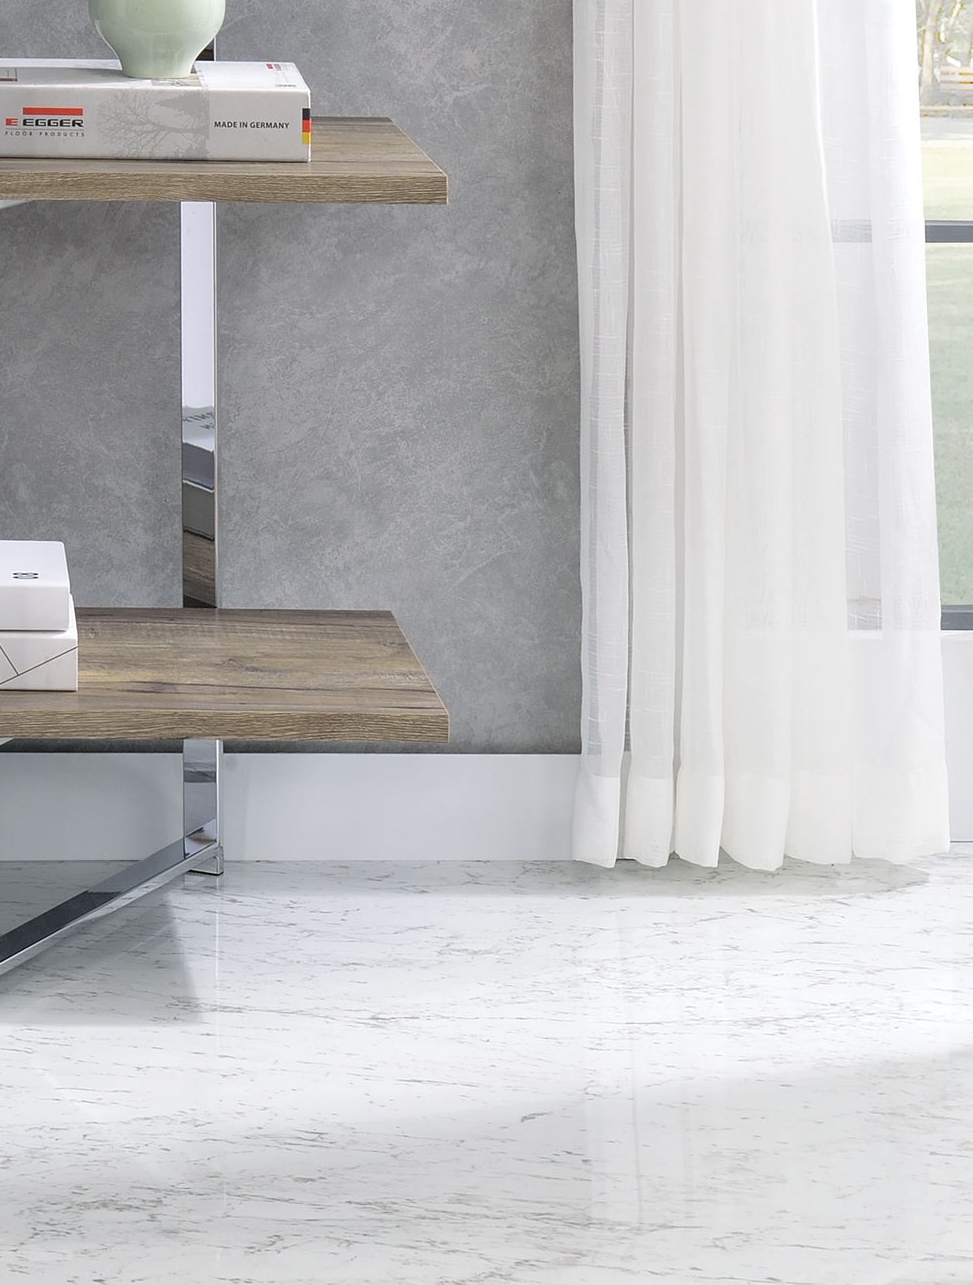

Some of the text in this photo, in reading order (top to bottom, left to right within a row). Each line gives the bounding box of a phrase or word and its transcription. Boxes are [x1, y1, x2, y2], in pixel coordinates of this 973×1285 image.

[22, 118, 84, 128] EGGER
[213, 120, 290, 130] MADE IN GERMANY
